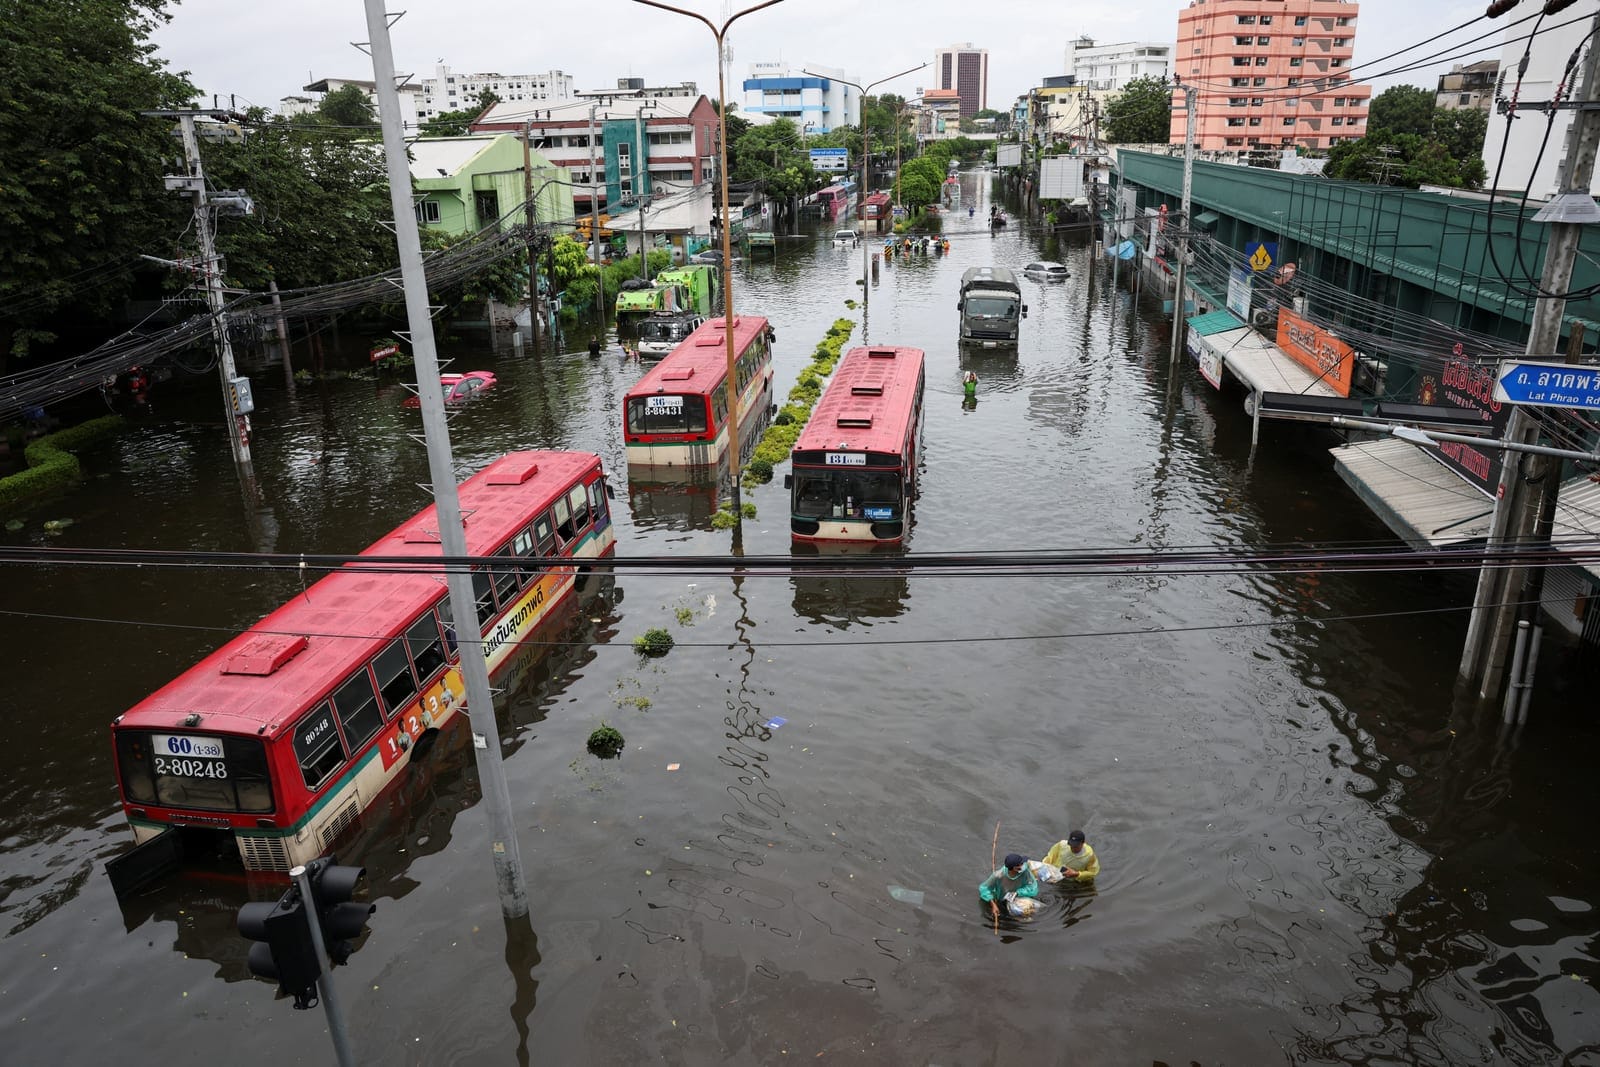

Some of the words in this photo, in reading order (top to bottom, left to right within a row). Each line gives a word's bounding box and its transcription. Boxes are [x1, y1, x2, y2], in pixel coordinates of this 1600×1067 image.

[1517, 372, 1531, 385] ถ.
[652, 398, 665, 406] 36
[1528, 391, 1545, 401] Lat
[1549, 392, 1579, 404] Phrao
[644, 406, 682, 416] 8-80431
[830, 455, 847, 464] 131
[429, 695, 438, 712] 3
[305, 718, 329, 745] 80248
[409, 716, 419, 733] 2
[167, 736, 192, 754] 60
[193, 743, 221, 757] (1-38)
[154, 757, 228, 779] 2-80248
